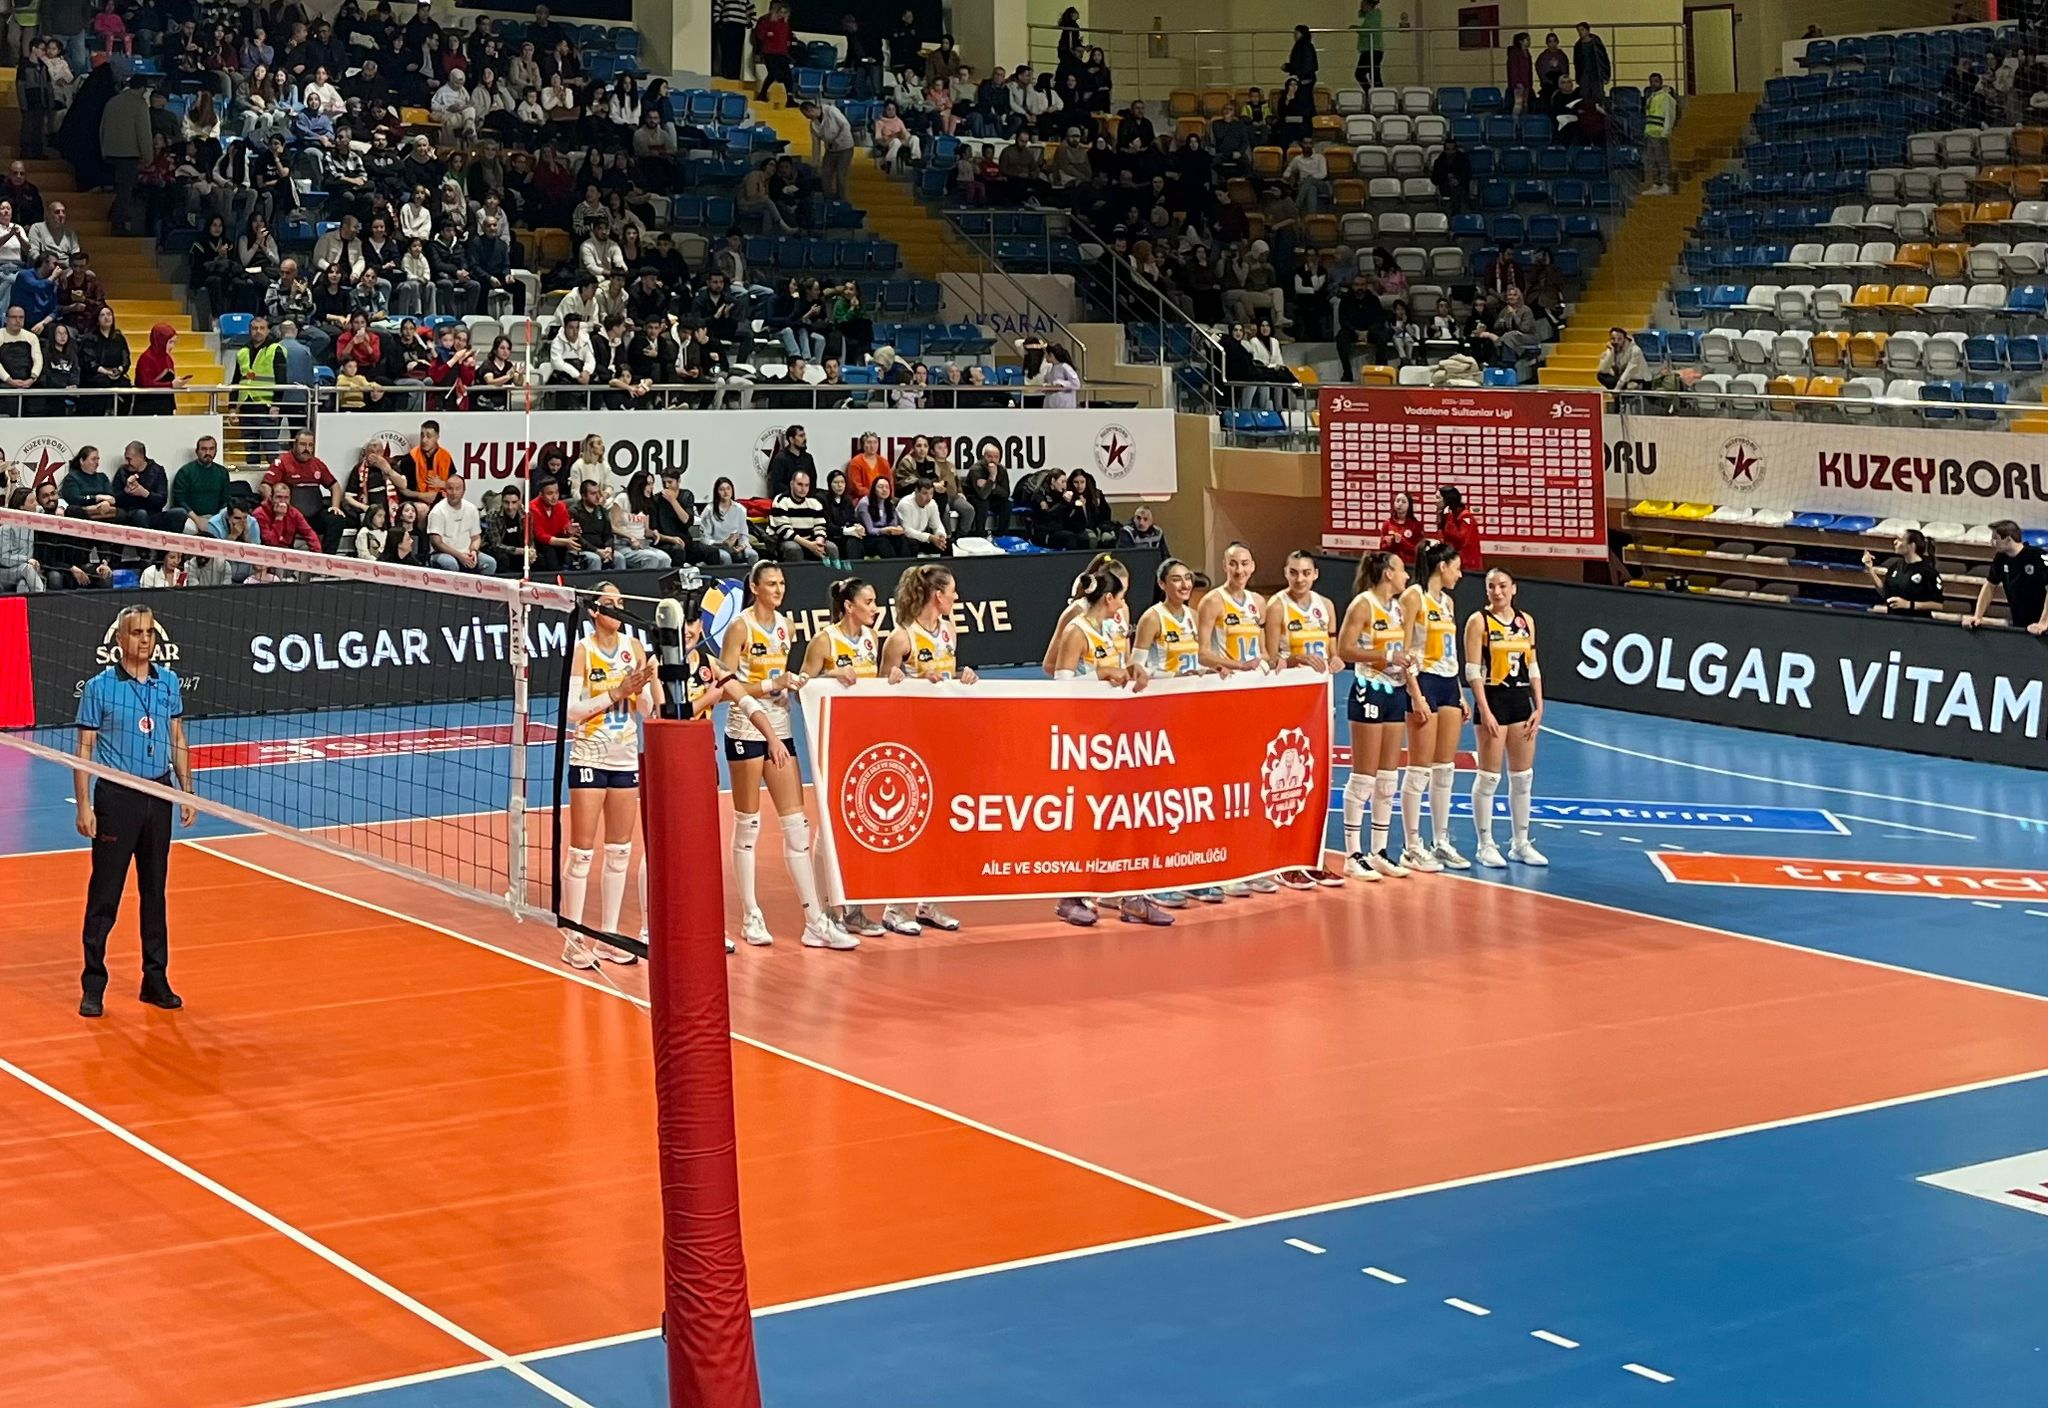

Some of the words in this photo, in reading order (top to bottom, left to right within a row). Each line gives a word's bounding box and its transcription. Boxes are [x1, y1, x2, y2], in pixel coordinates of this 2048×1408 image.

[1404, 406, 1449, 416] Vodafone
[1451, 406, 1494, 417] Sultanlar
[1496, 408, 1513, 419] Ligi
[463, 438, 689, 480] KUZORU
[1818, 451, 2048, 500] KUZEYBORU
[96, 644, 180, 664] SOAR
[250, 628, 431, 674] SOLGAR
[1507, 651, 1520, 677] 5
[1576, 627, 1816, 709] SOLGAR
[1839, 650, 2044, 739] VİTAM
[1362, 702, 1380, 719] 19
[734, 740, 746, 755] 6
[1050, 725, 1176, 771] İNSANA
[579, 767, 594, 783] 10
[949, 785, 1075, 833] SEVGİ
[1085, 786, 1216, 835] YAKIŞIR
[1223, 782, 1251, 820] !!!
[982, 859, 1011, 876] AİLE
[1014, 861, 1031, 875] VE
[1033, 859, 1083, 875] SOSYAL
[1086, 857, 1150, 873] HİZMETLER
[1152, 854, 1163, 870] İL
[1165, 847, 1228, 869] MÜDÜRLÜĞÜ
[1775, 865, 2048, 892] trend
